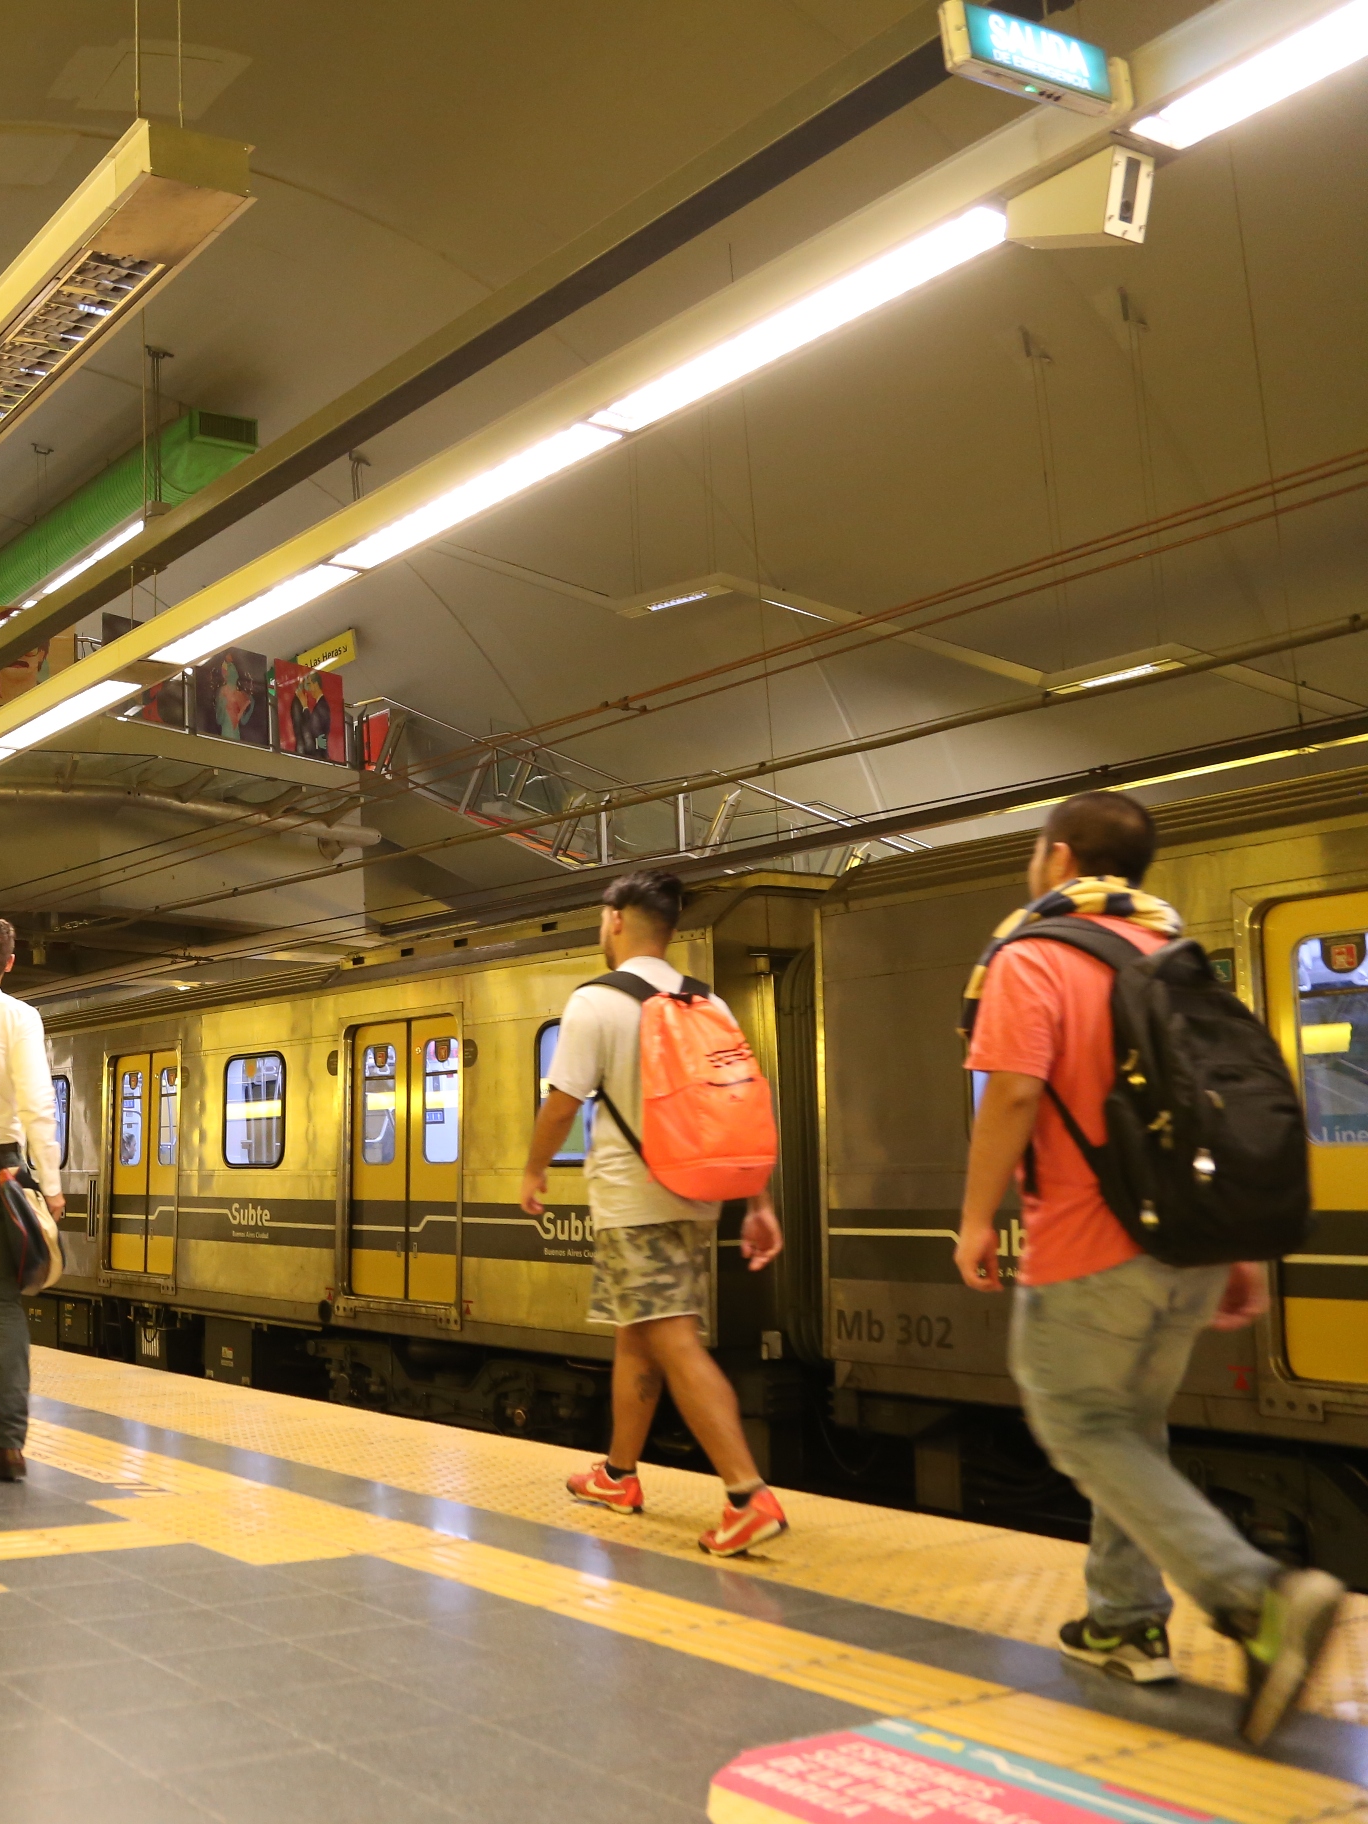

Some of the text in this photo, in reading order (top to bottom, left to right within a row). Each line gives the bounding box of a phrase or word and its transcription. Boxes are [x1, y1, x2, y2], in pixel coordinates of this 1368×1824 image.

[988, 13, 1090, 78] SALIDA
[993, 49, 1092, 90] DE EMERGENCIA
[309, 647, 342, 668] Las Heras
[232, 1203, 270, 1226] Subte
[542, 1211, 594, 1242] Subt
[566, 1249, 582, 1257] Aires
[837, 1310, 954, 1350] Mb 302
